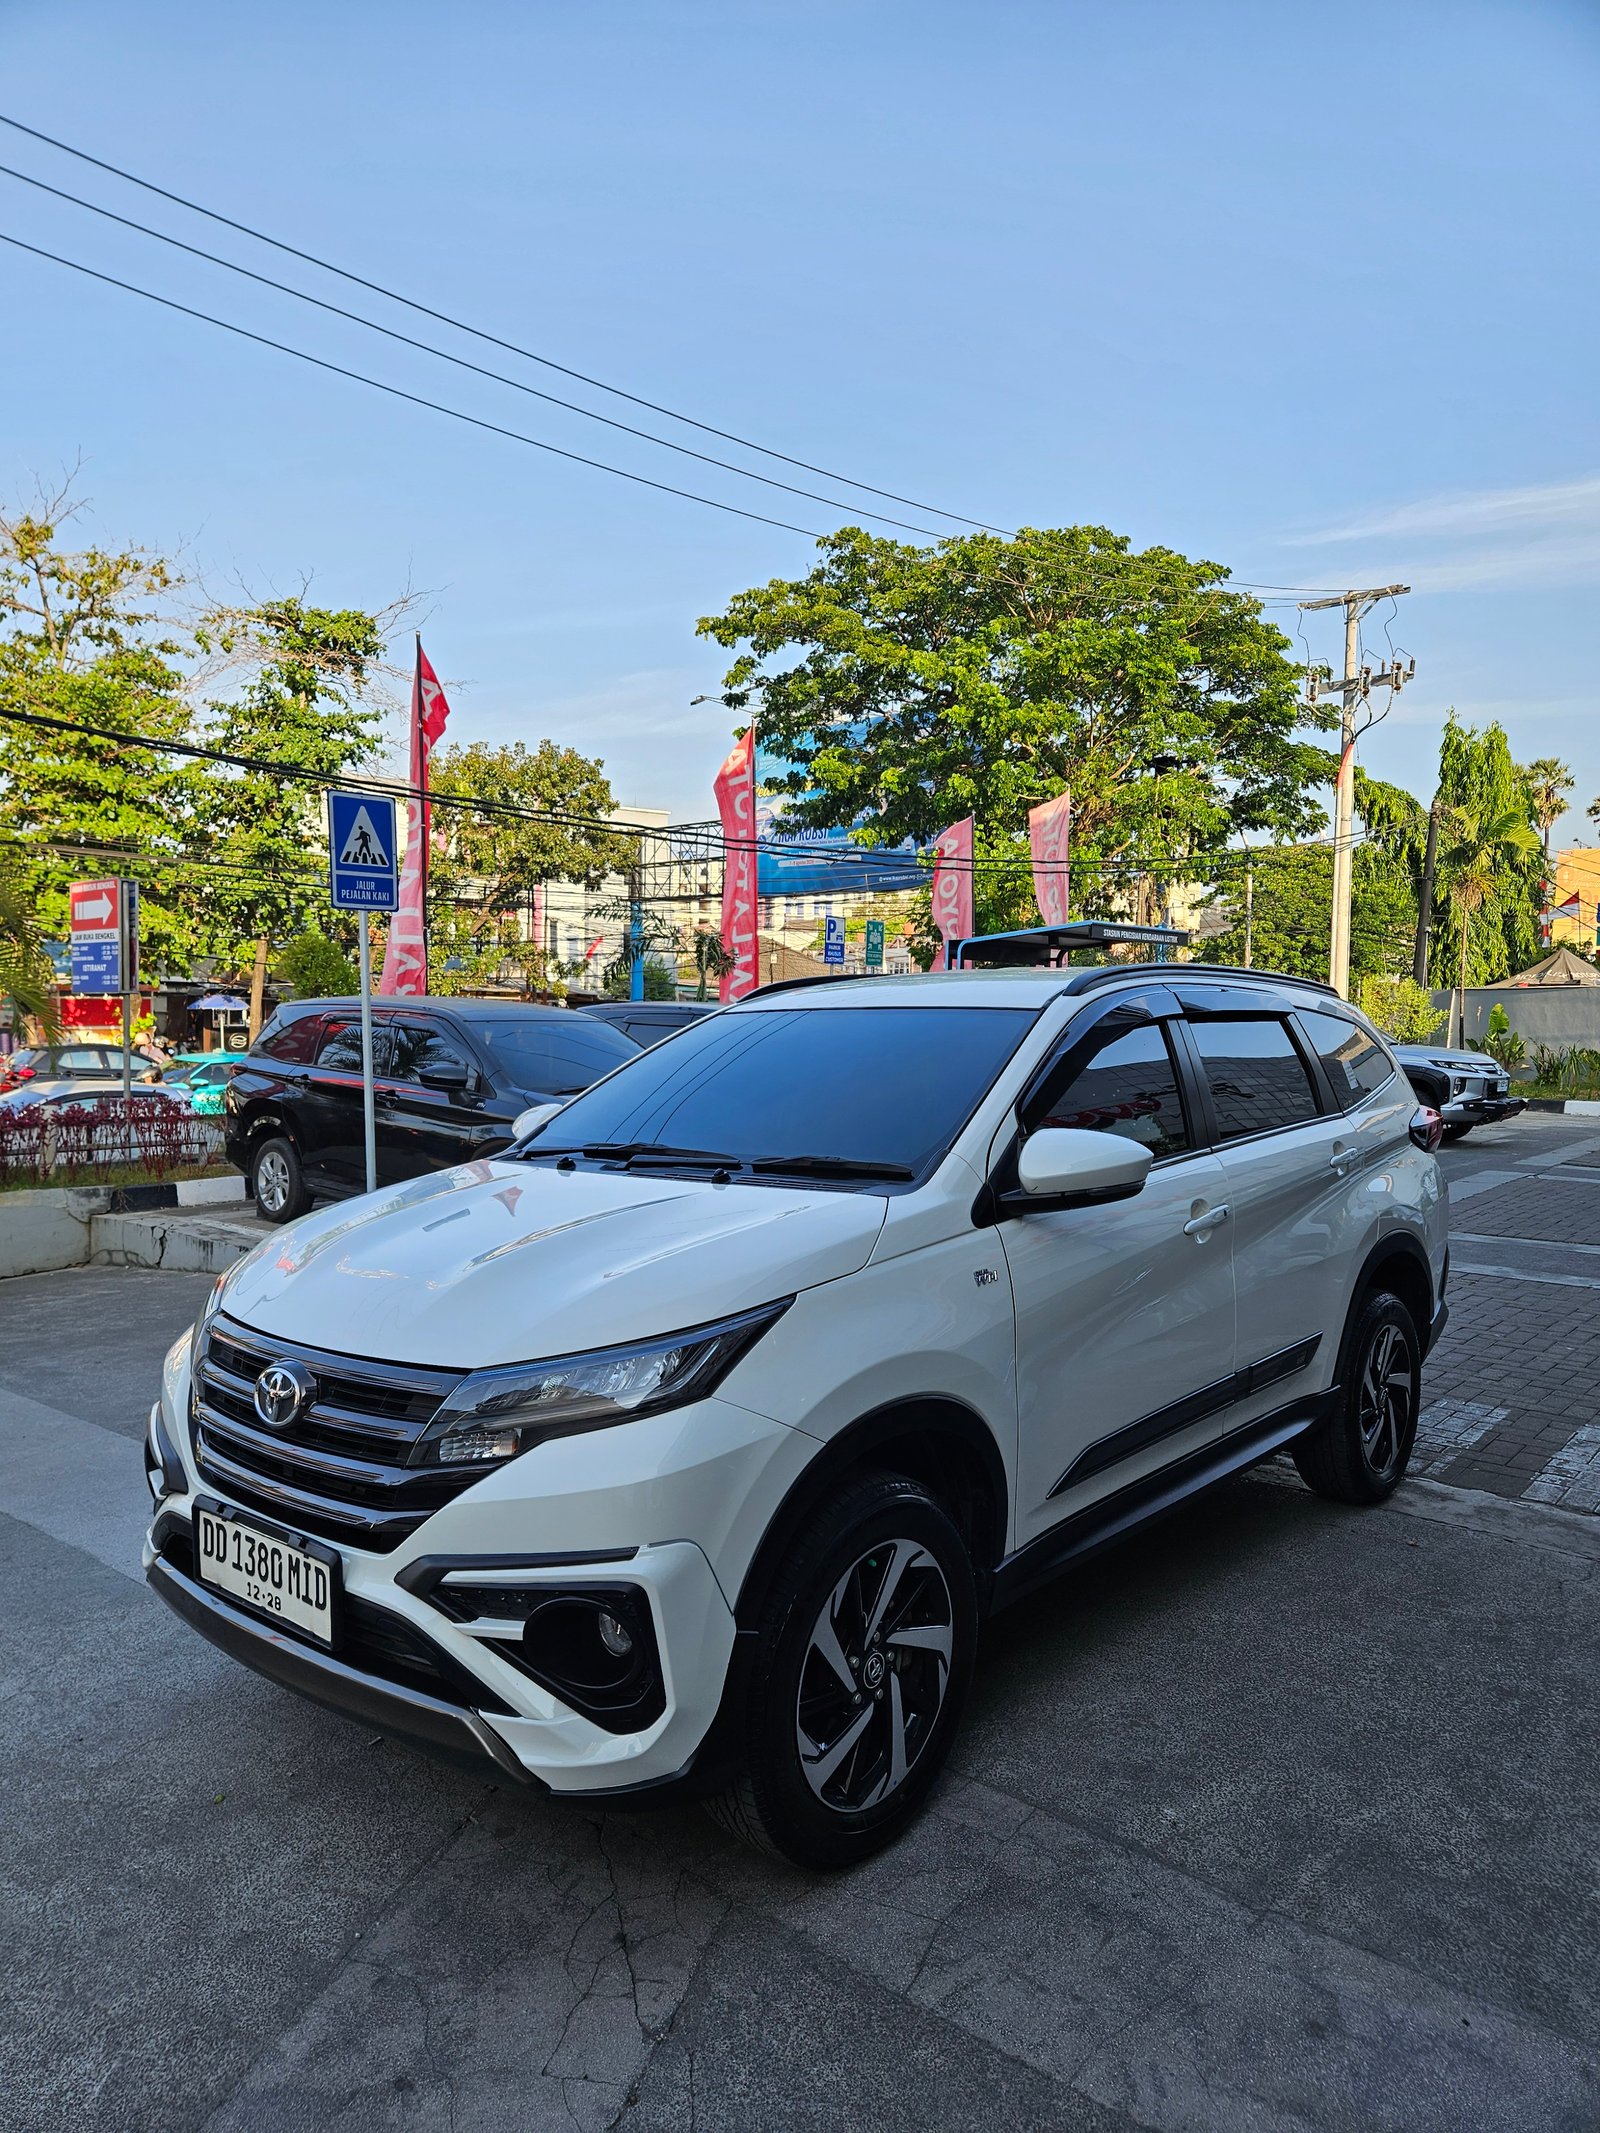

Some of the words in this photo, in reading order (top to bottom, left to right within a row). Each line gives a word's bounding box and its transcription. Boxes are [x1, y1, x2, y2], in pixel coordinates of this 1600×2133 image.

[355, 880, 375, 890] JALUR
[341, 889, 371, 900] PEJALAN
[372, 891, 390, 901] KAKI
[827, 919, 836, 941] P
[1103, 928, 1121, 938] STASIUN
[1121, 931, 1141, 940] PENGISIAN
[1142, 933, 1164, 942] KENDARAAN
[1165, 935, 1178, 943] LISTRIK
[82, 964, 107, 972] ISTIRAHAT
[203, 1517, 227, 1563] DD
[231, 1529, 283, 1589] 1380
[288, 1553, 327, 1611] MID
